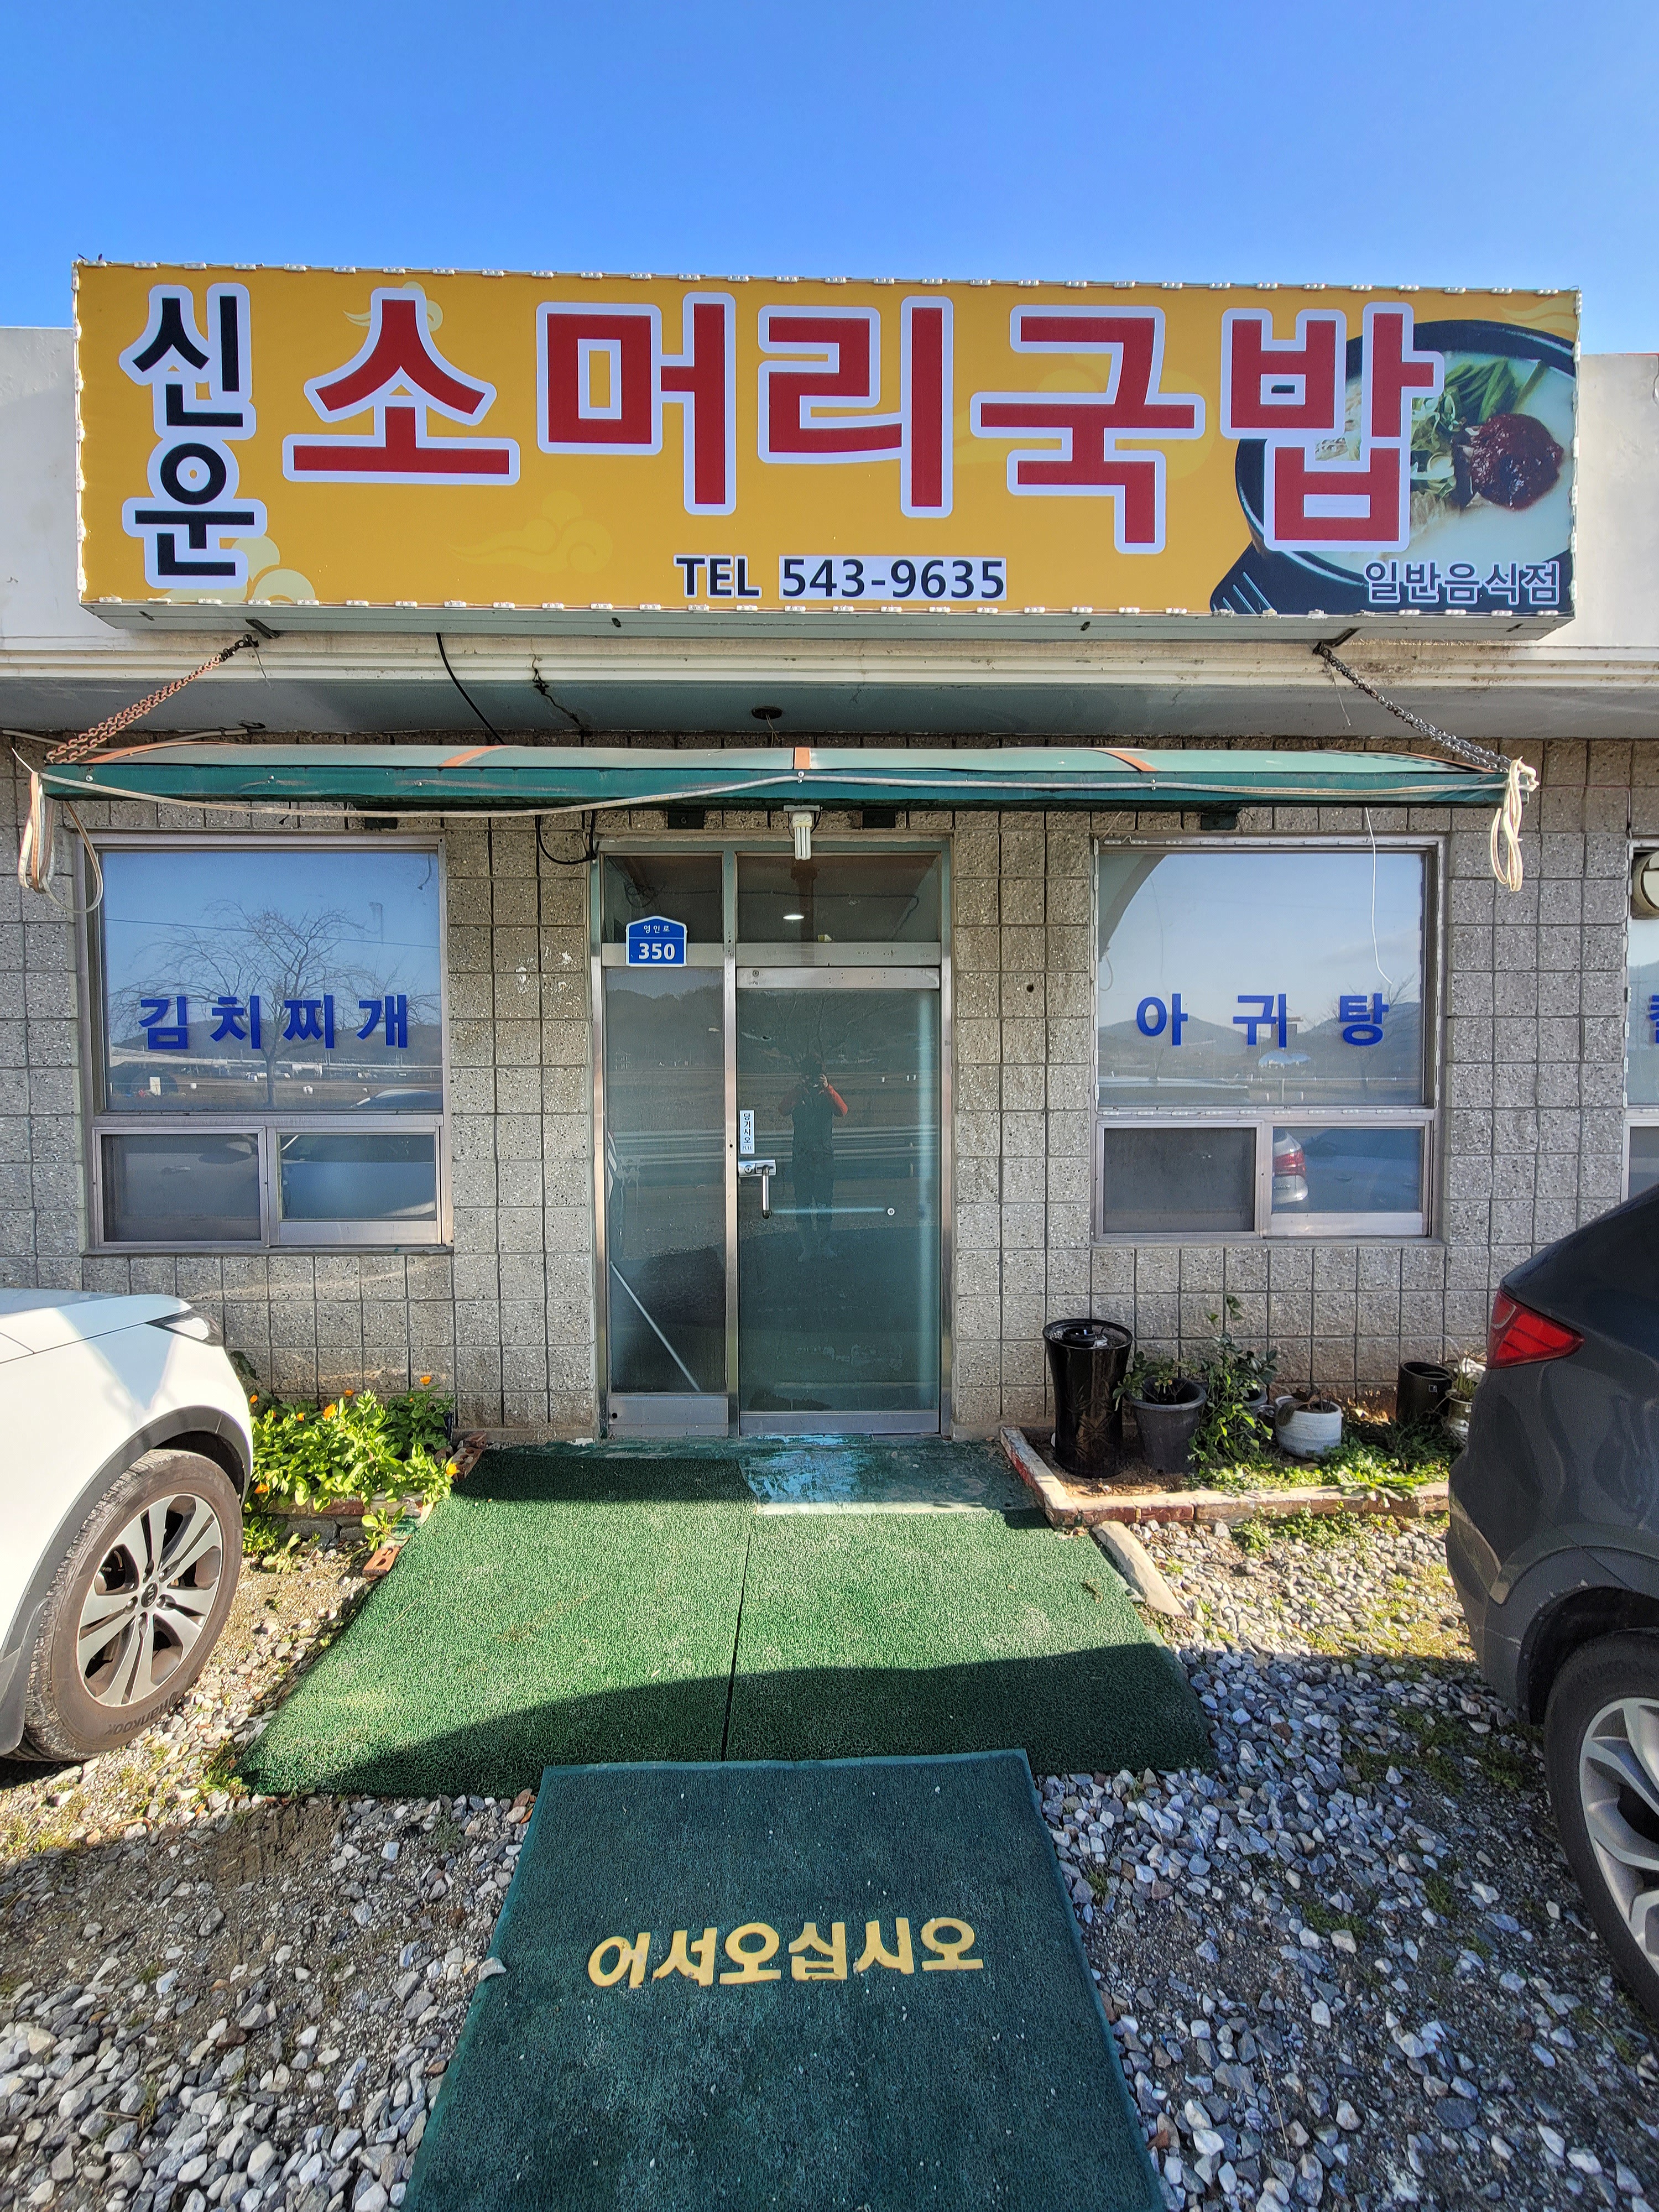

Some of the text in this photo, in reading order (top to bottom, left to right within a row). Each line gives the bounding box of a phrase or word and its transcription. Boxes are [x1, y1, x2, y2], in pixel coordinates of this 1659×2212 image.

[131, 294, 257, 578] 신운
[291, 296, 1436, 545] 소머리국밥
[675, 557, 1005, 599] TEL 543-9635
[1365, 560, 1558, 603] 일반음식점
[638, 942, 675, 961] 350
[643, 924, 670, 934] 영인로
[137, 994, 409, 1050] 김치찌개
[1136, 993, 1390, 1048] 아귀탕
[743, 1113, 752, 1144] 당기시오
[587, 1916, 983, 1989] 어서오십시오
